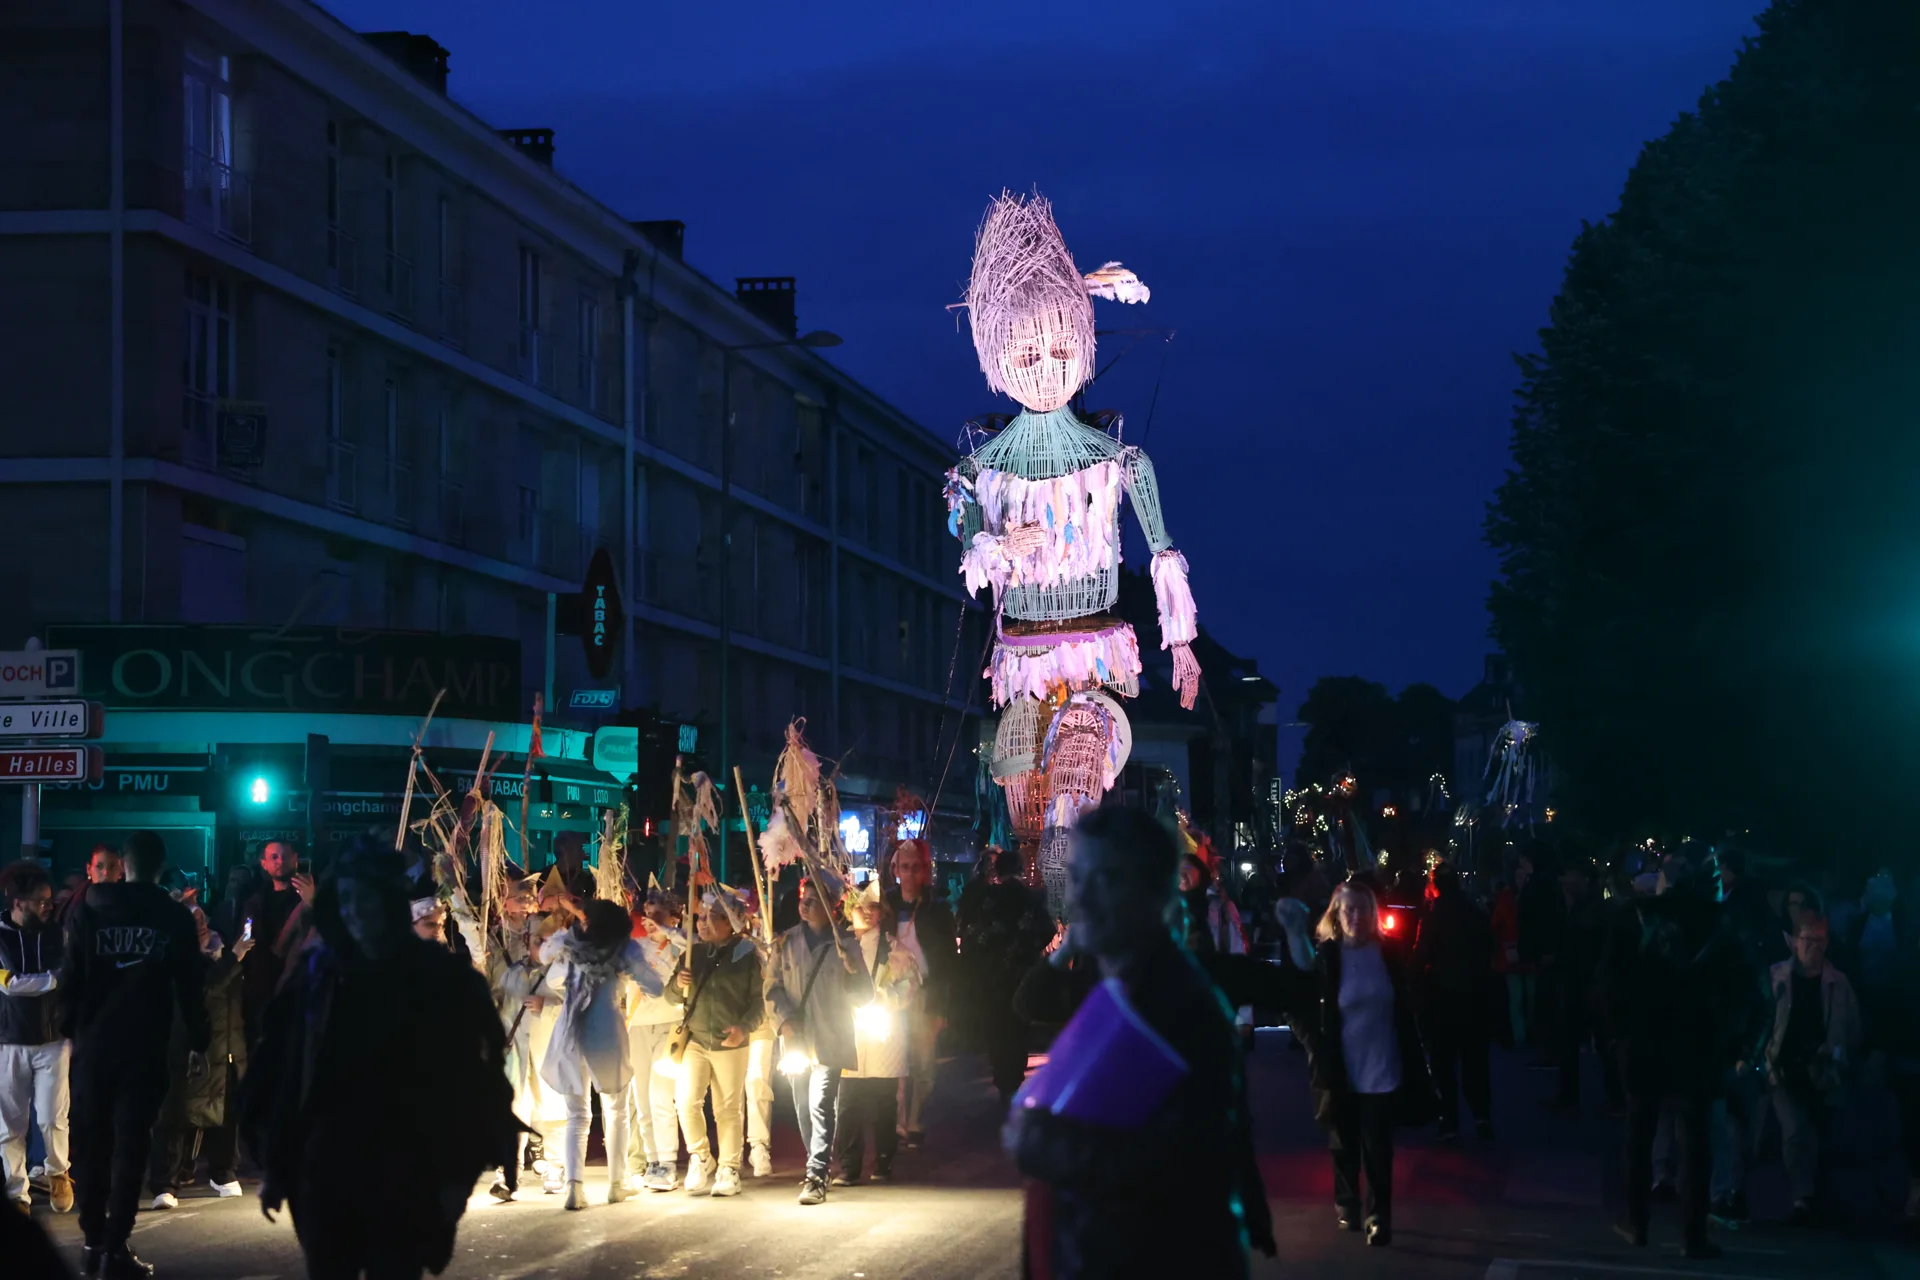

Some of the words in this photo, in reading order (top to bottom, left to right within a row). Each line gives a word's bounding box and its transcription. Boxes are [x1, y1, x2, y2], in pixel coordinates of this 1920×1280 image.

[593, 585, 606, 646] TABAC
[1, 665, 43, 682] OCH
[84, 648, 512, 710] ONGCHAMP
[574, 693, 598, 704] FDJ
[32, 710, 79, 728] Ville
[9, 755, 76, 773] Halles
[119, 773, 169, 791] PMU
[489, 779, 526, 797] TABAC
[567, 785, 580, 800] PMU
[594, 788, 609, 803] LOTO
